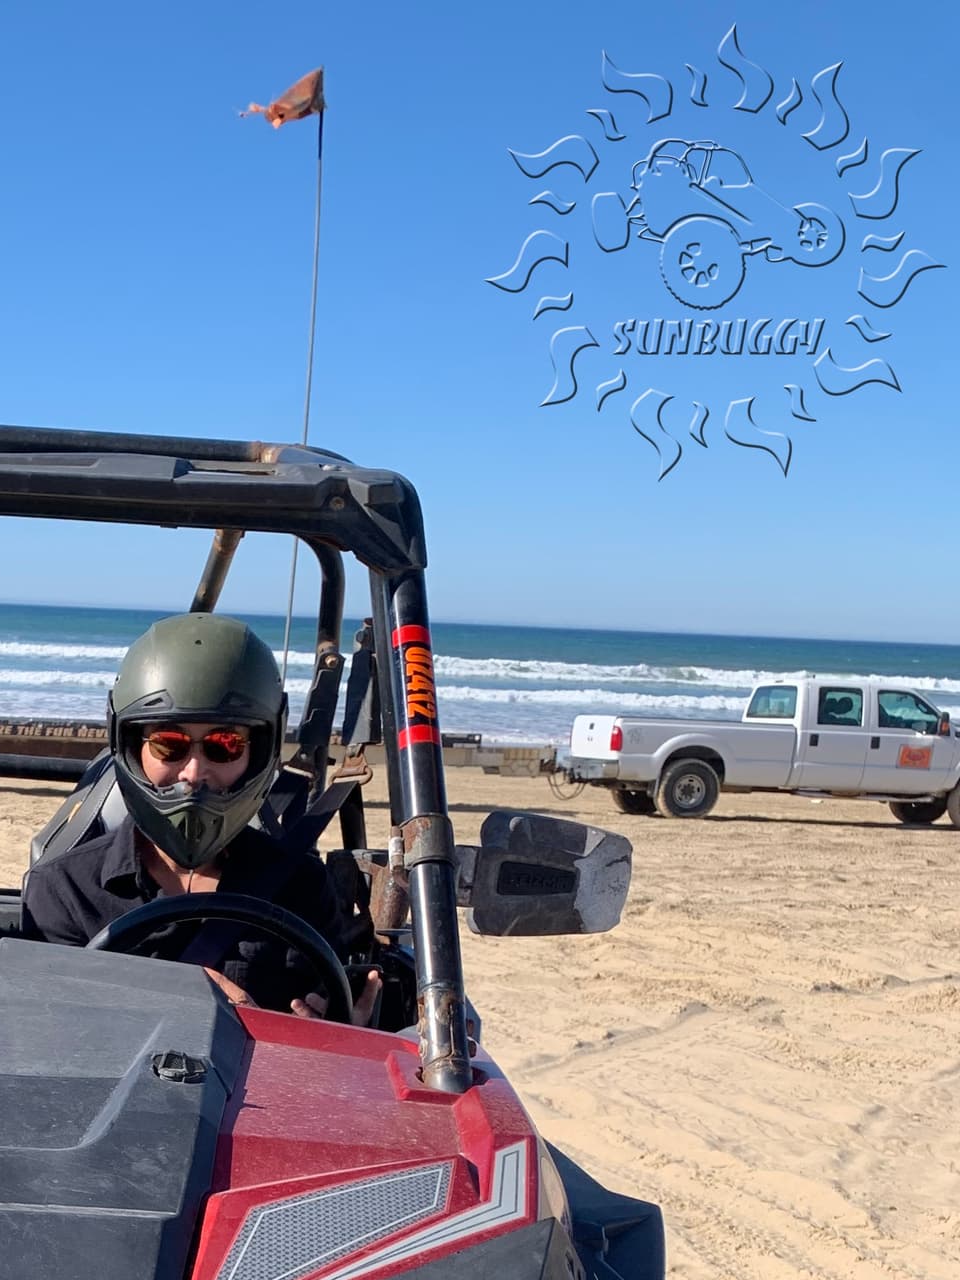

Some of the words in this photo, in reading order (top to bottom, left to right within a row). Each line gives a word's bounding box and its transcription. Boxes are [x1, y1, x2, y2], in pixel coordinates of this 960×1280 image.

[405, 646, 436, 718] 02412
[17, 726, 42, 736] THE
[45, 727, 74, 737] FUN
